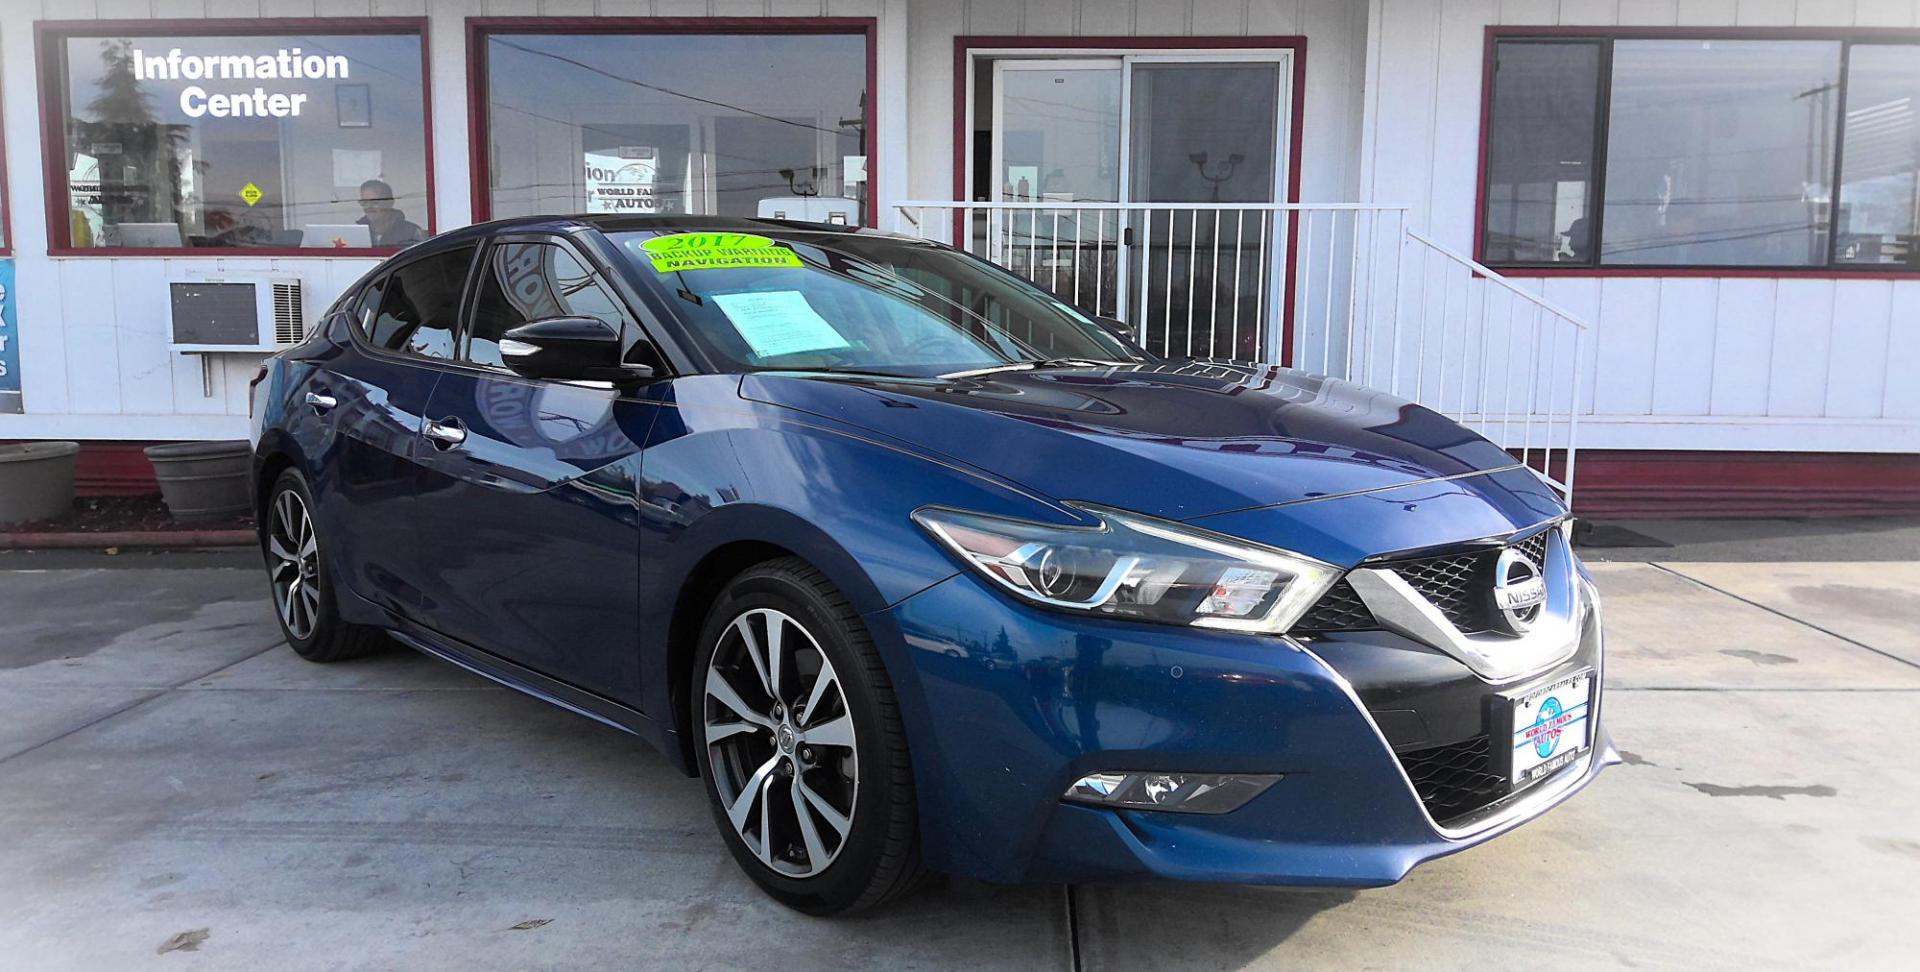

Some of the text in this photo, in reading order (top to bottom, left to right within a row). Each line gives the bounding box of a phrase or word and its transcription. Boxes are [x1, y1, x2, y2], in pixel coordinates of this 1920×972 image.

[133, 48, 349, 80] Information
[180, 86, 307, 118] Center
[667, 235, 747, 250] 2017
[650, 249, 713, 261] BACKUP
[666, 256, 788, 268] NAVIGATION
[1508, 585, 1546, 605] NISSA
